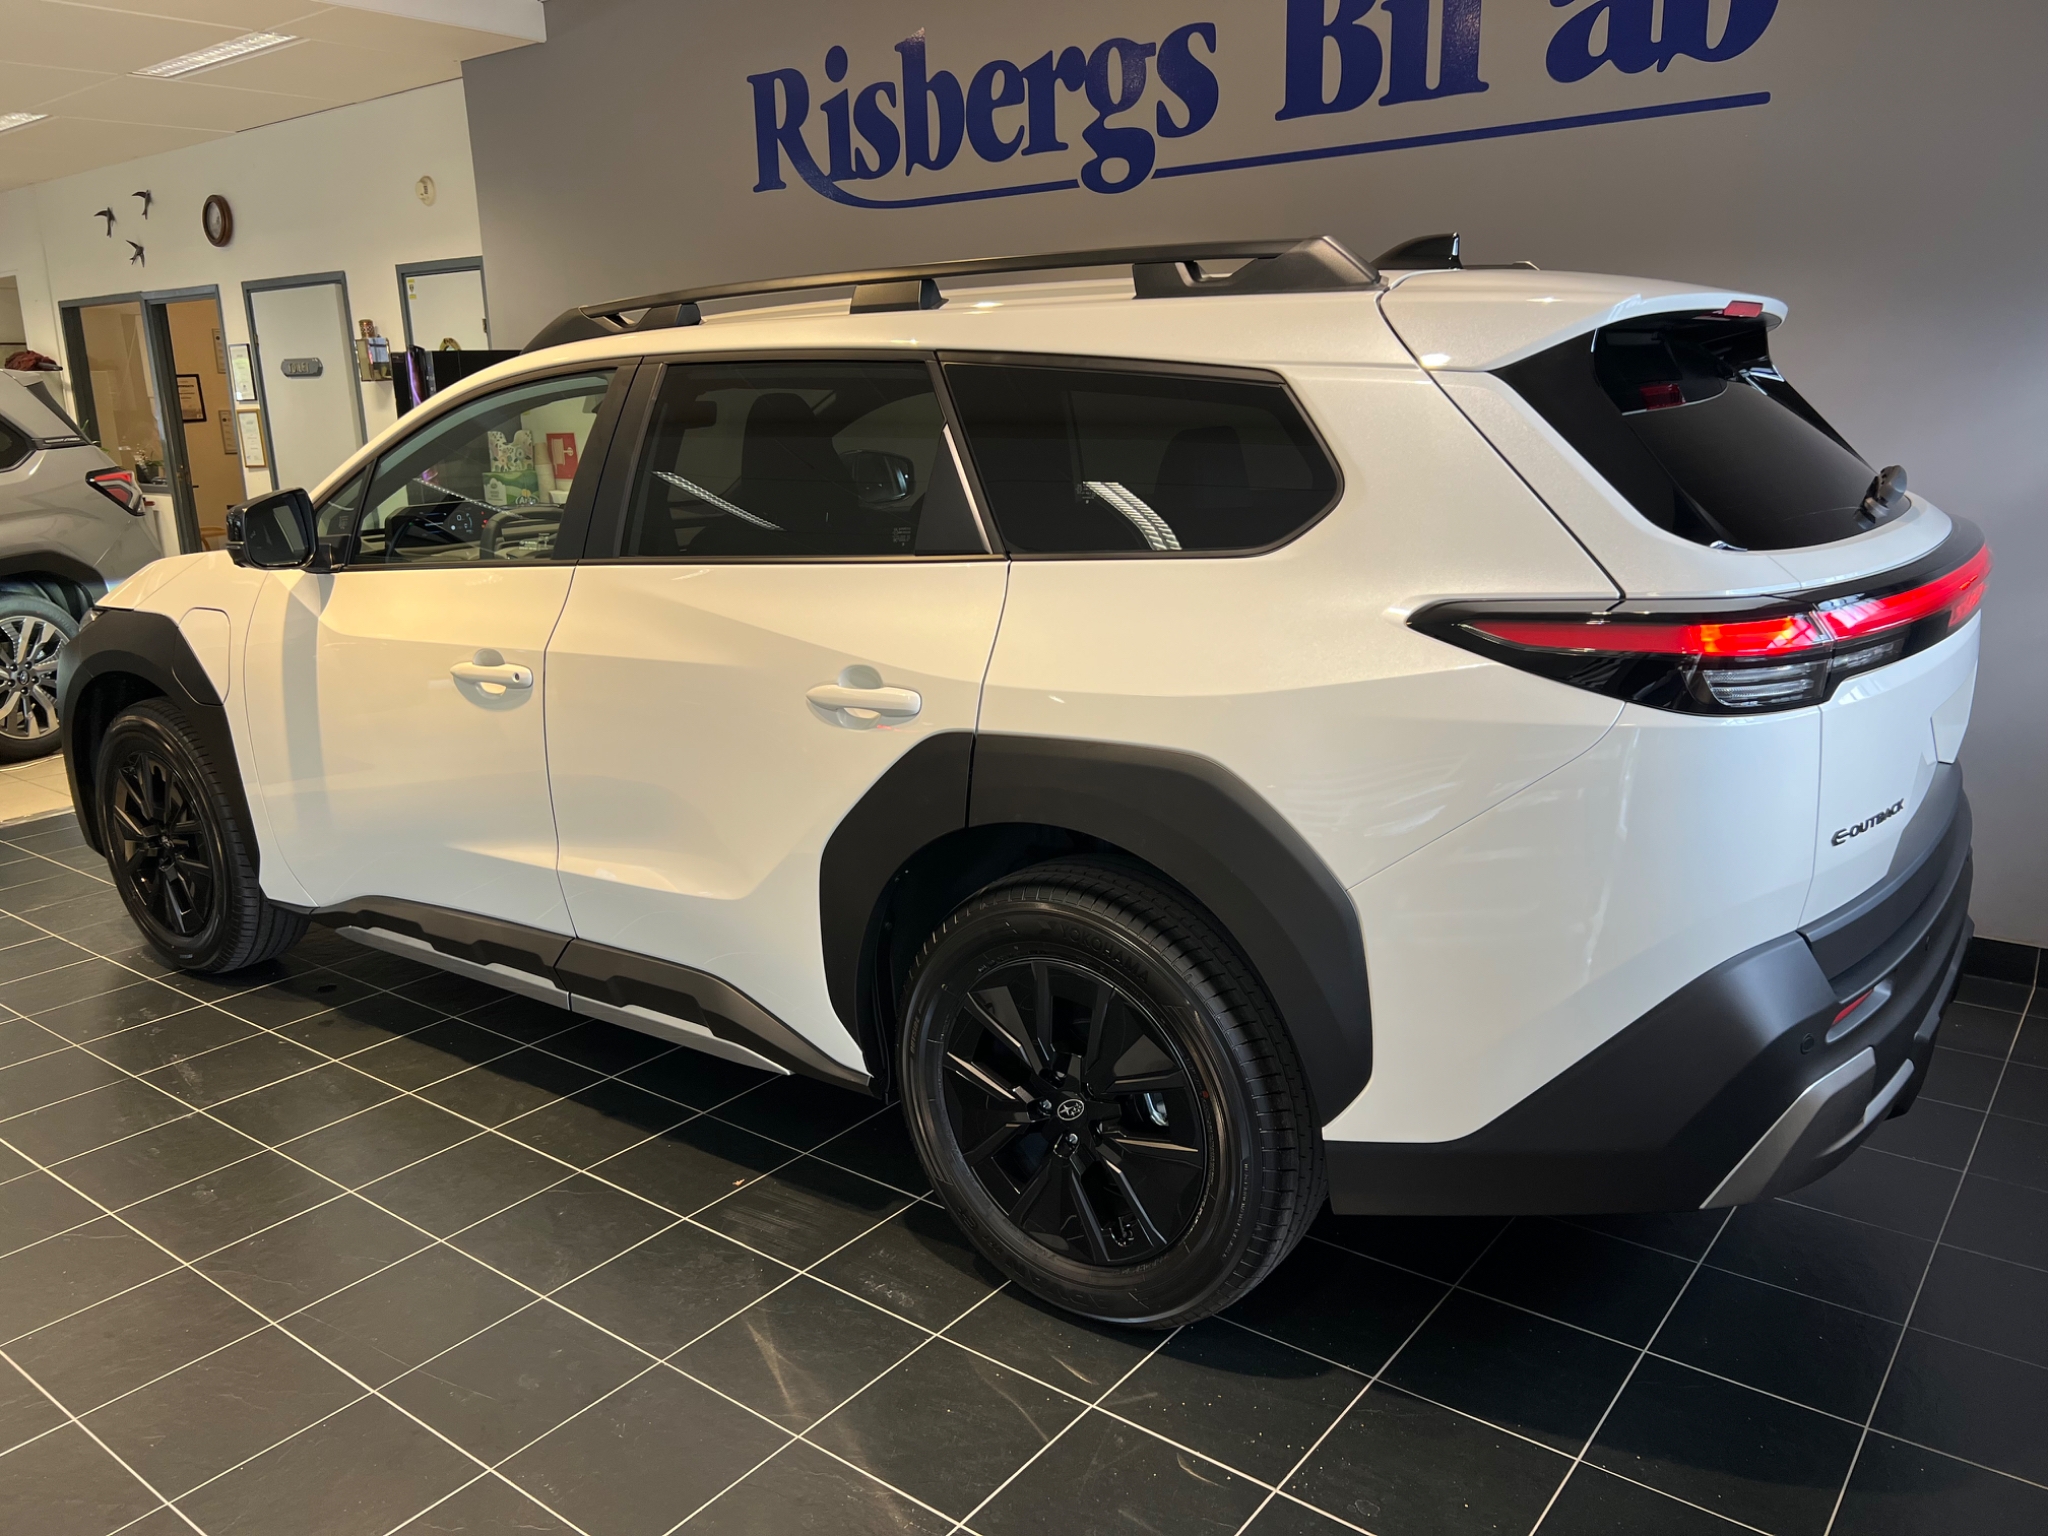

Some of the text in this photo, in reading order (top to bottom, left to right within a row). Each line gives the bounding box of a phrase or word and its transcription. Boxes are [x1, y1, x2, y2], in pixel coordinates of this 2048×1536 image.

[747, 20, 1218, 196] Risbergs
[1275, 0, 1489, 121] Bil
[1060, 922, 1150, 985] YOKOHAMA
